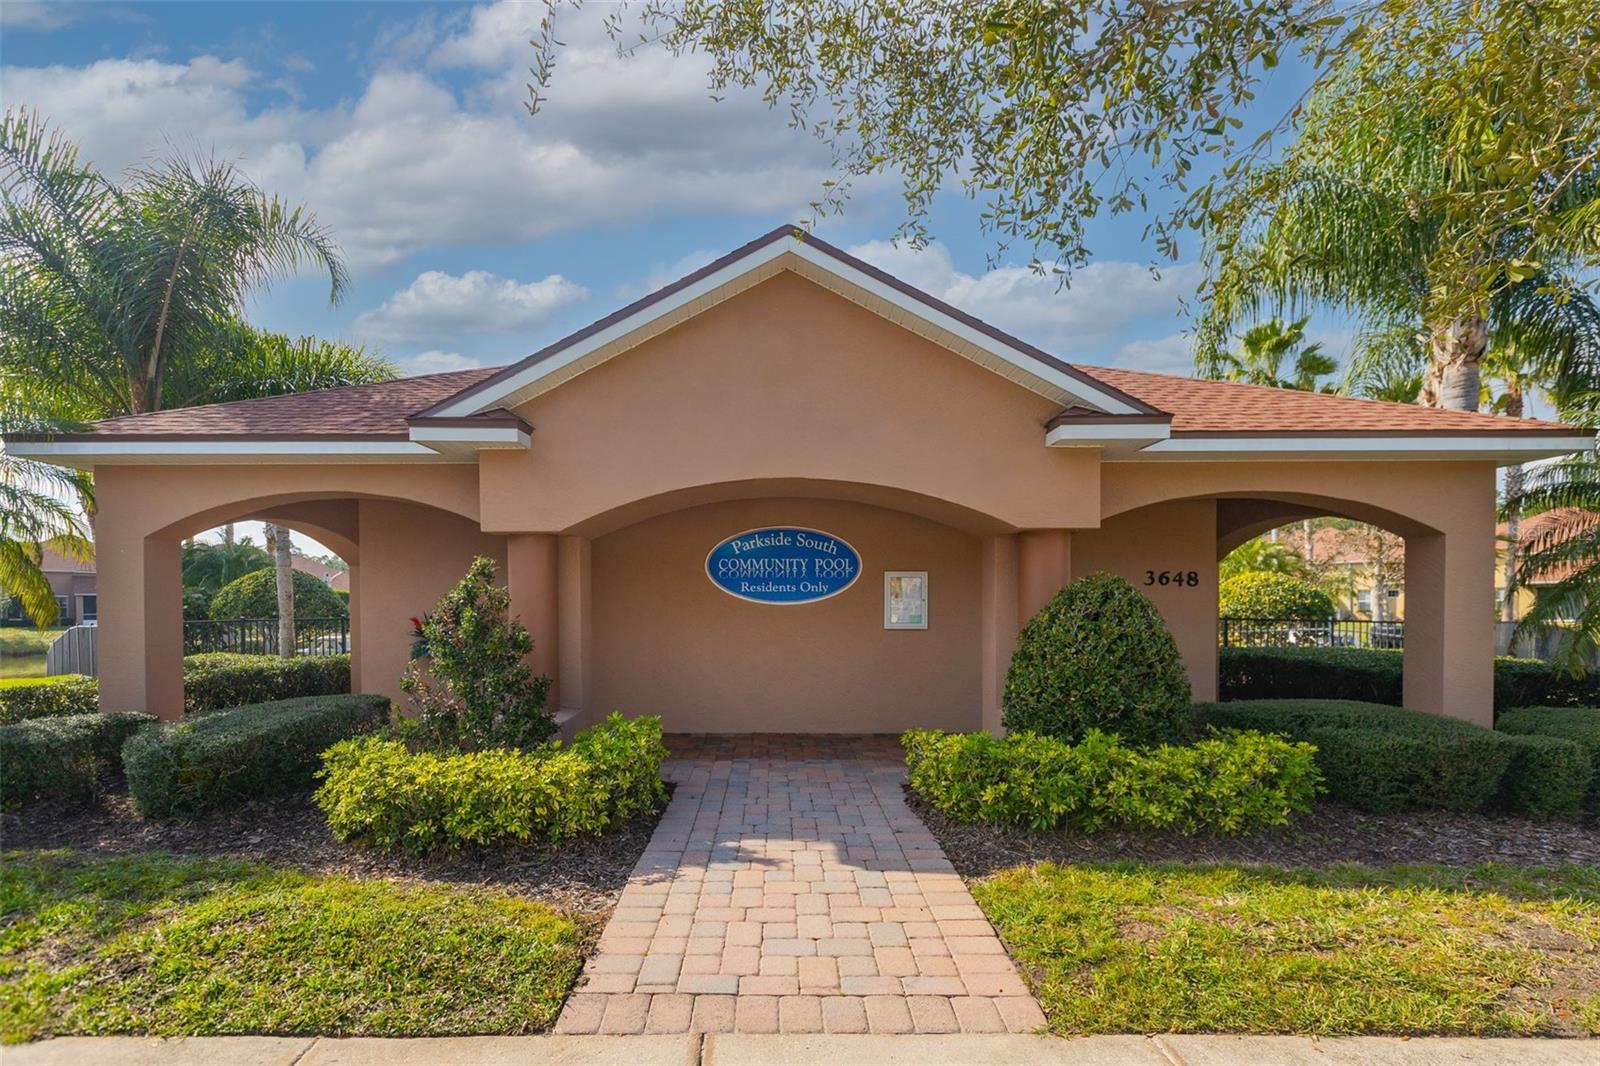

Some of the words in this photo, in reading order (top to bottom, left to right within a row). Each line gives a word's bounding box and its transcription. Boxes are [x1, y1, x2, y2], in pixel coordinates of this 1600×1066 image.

[731, 532, 792, 554] Parkside
[796, 533, 838, 554] South
[718, 558, 809, 570] COMMUNITY
[815, 558, 853, 570] POOL
[1143, 570, 1200, 587] 3648
[741, 582, 797, 592] Residents
[800, 582, 829, 594] Only
